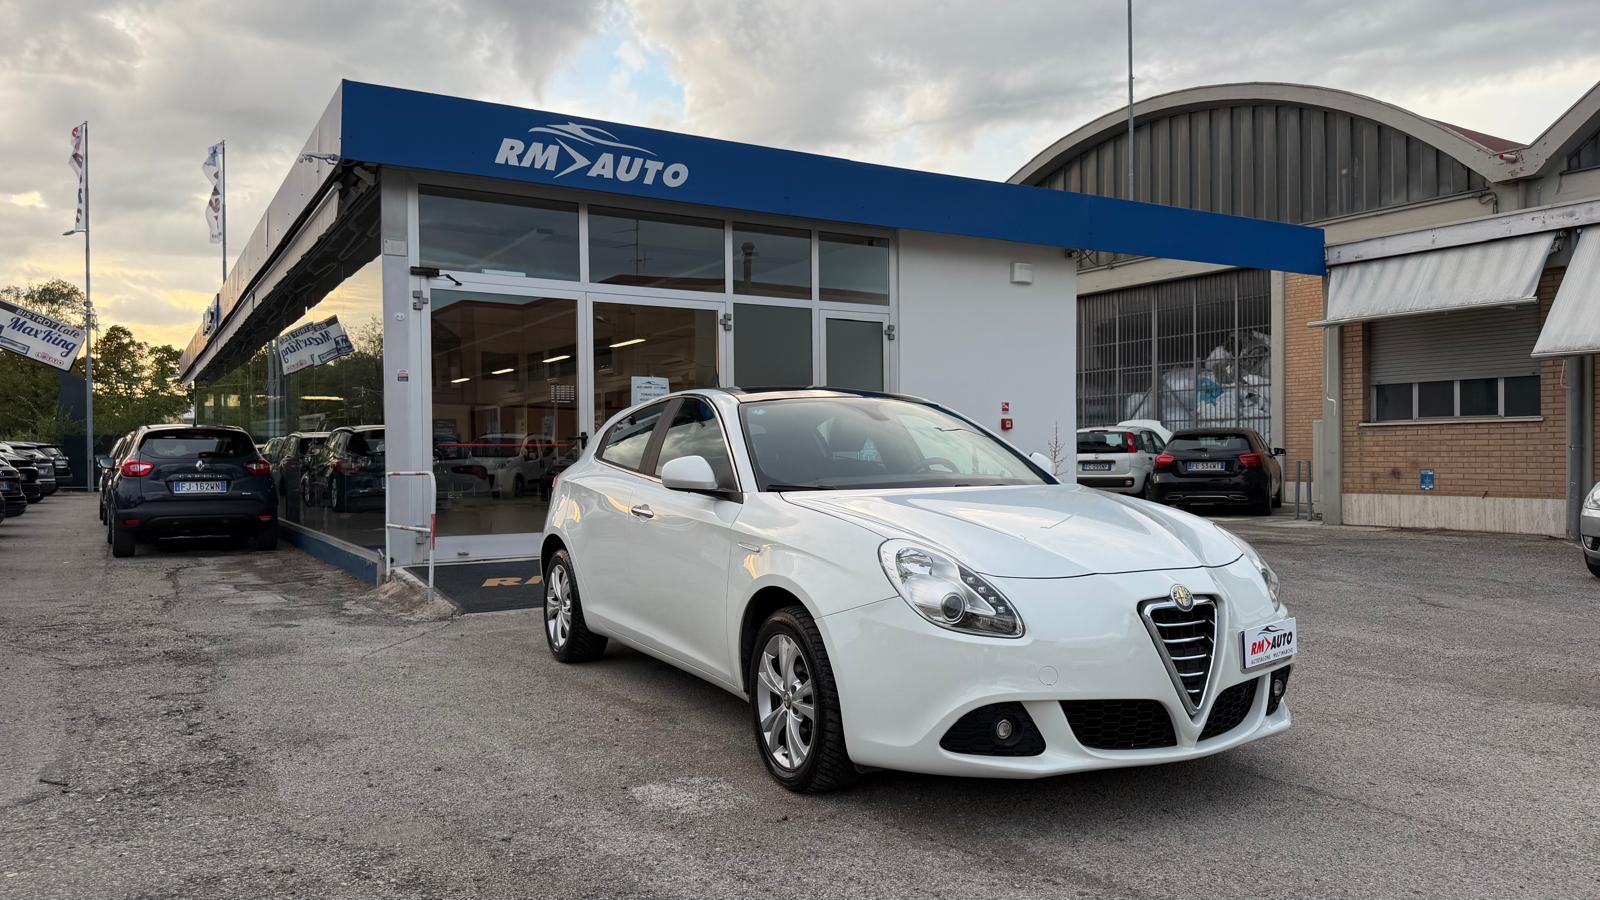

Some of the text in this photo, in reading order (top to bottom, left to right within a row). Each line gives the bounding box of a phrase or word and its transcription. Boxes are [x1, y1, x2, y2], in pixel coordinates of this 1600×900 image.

[495, 138, 689, 188] RM AUTO
[16, 309, 58, 330] BISTROT
[1251, 632, 1293, 655] RM AUTO
